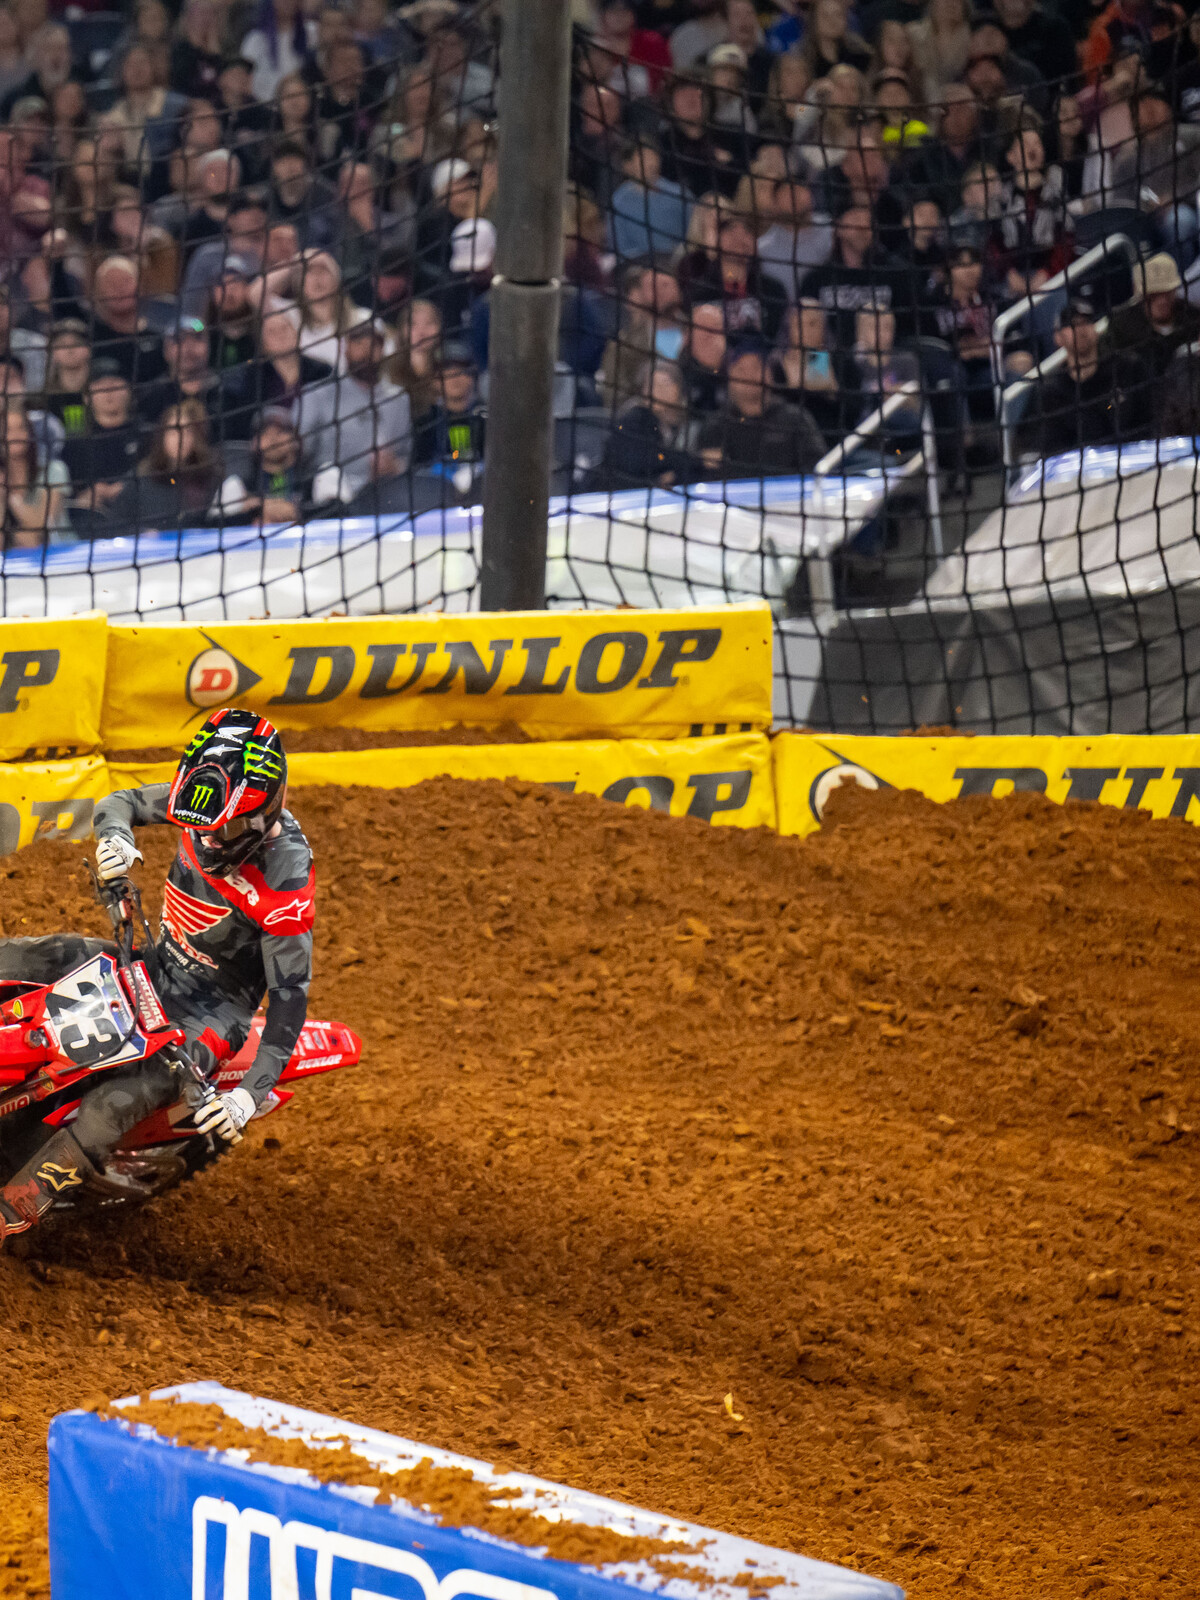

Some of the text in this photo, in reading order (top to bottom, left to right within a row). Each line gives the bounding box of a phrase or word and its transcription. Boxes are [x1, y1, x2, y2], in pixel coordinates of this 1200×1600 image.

[193, 628, 723, 706] D DUNLOP
[174, 809, 213, 825] MONSTER
[44, 981, 124, 1066] 23
[295, 1053, 343, 1071] DUNLOP
